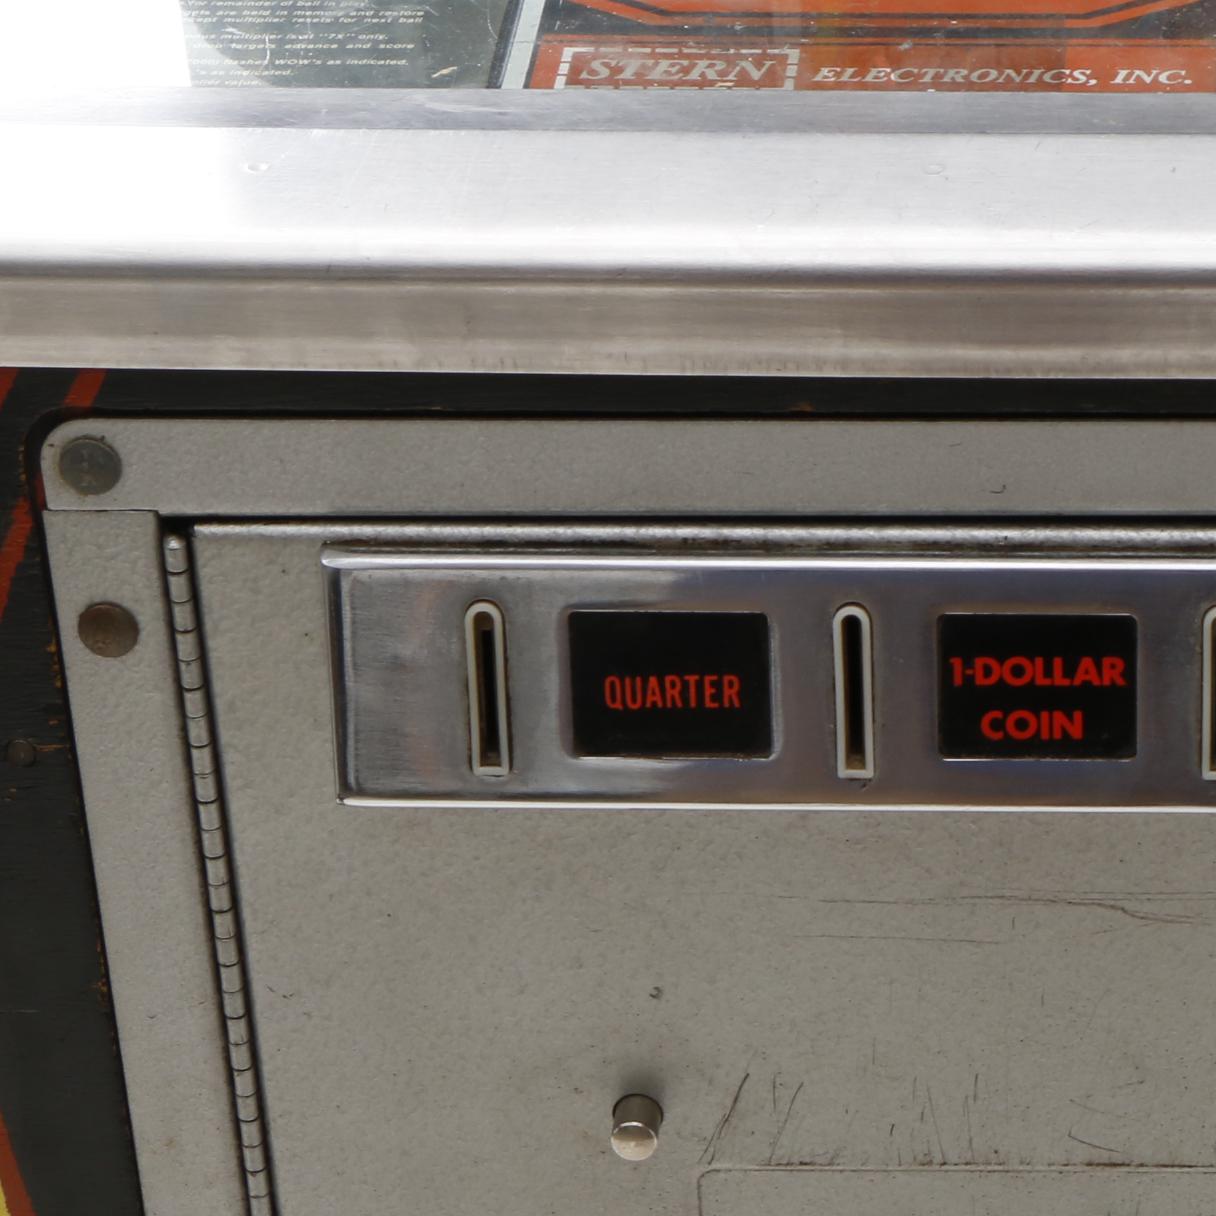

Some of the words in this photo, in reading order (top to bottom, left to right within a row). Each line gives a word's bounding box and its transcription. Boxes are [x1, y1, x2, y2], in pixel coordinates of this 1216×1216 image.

[579, 58, 774, 80] STERN
[810, 66, 1096, 86] ELECTRONICS,
[1109, 69, 1192, 85] INC.
[949, 656, 1126, 687] 1-DOLLAR
[603, 675, 742, 709] QUARTER
[979, 710, 1084, 740] COIN
